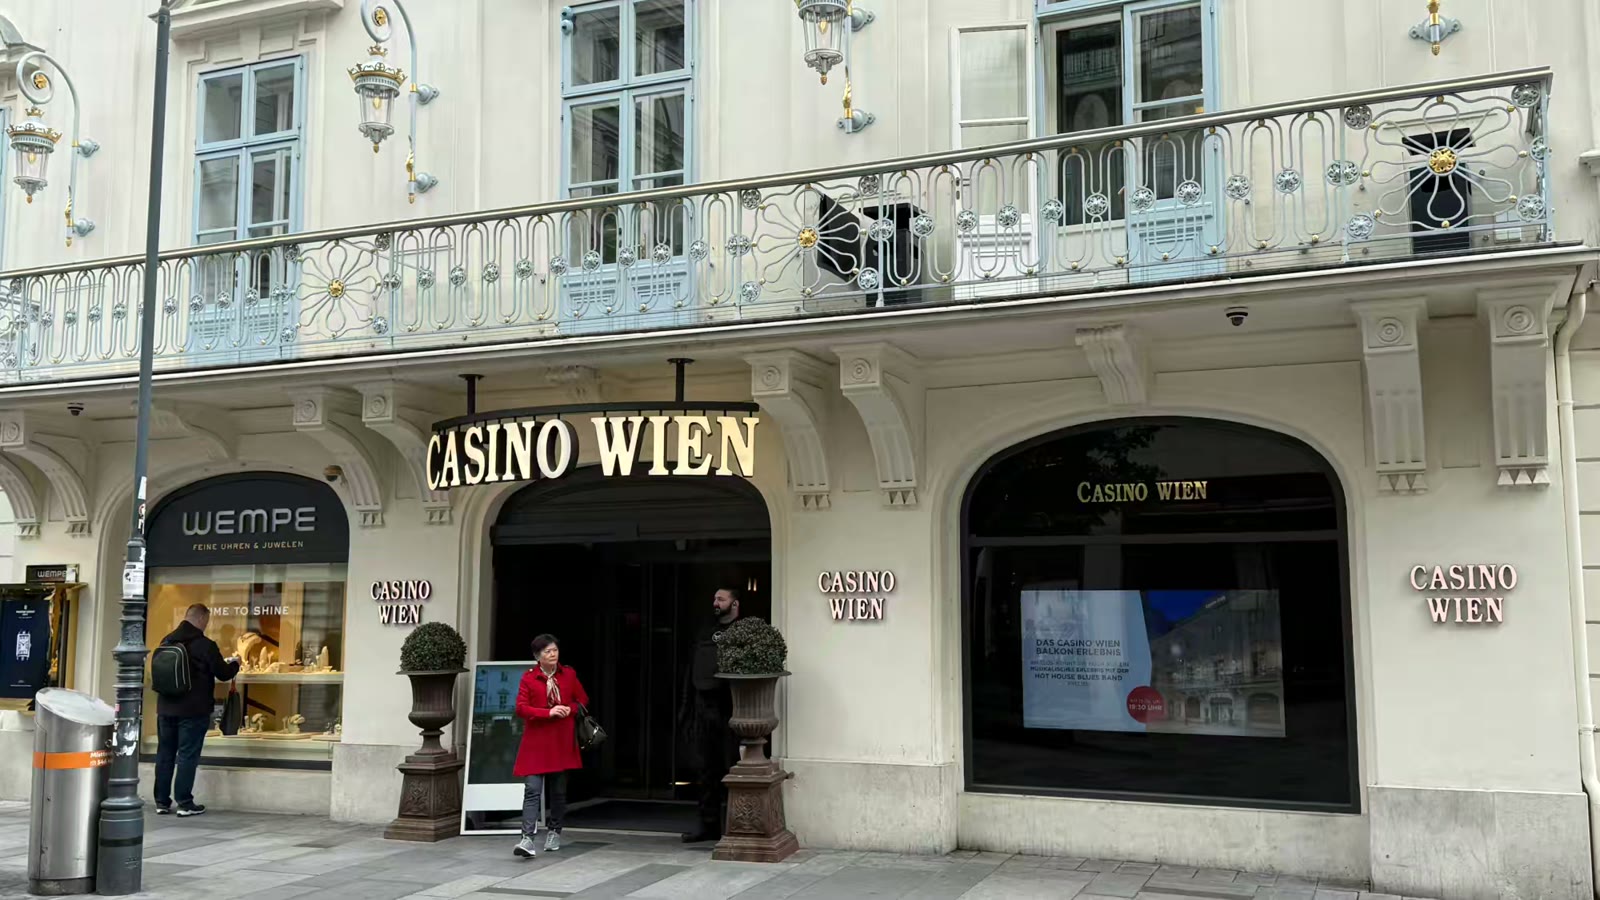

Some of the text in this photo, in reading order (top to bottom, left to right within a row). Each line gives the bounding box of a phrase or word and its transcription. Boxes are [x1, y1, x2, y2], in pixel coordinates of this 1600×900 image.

[426, 416, 760, 491] CASINO WIEN
[1077, 481, 1208, 503] CASINO WIEN
[182, 507, 316, 536] WEMPE
[192, 540, 304, 551] FEINE UHREN & JUWELEN
[818, 570, 896, 593] CASINO
[1410, 564, 1518, 590] CASINO
[370, 580, 431, 600] CASINO
[208, 605, 290, 616] IME TO SHINE
[378, 604, 422, 624] WIEN
[829, 598, 885, 620] WIEN
[1426, 597, 1504, 623] WIEN
[1036, 639, 1121, 648] DAS CASINO WIEN
[1036, 647, 1121, 656] BALKON ERLEBNIS
[1051, 673, 1076, 681] HOUSE
